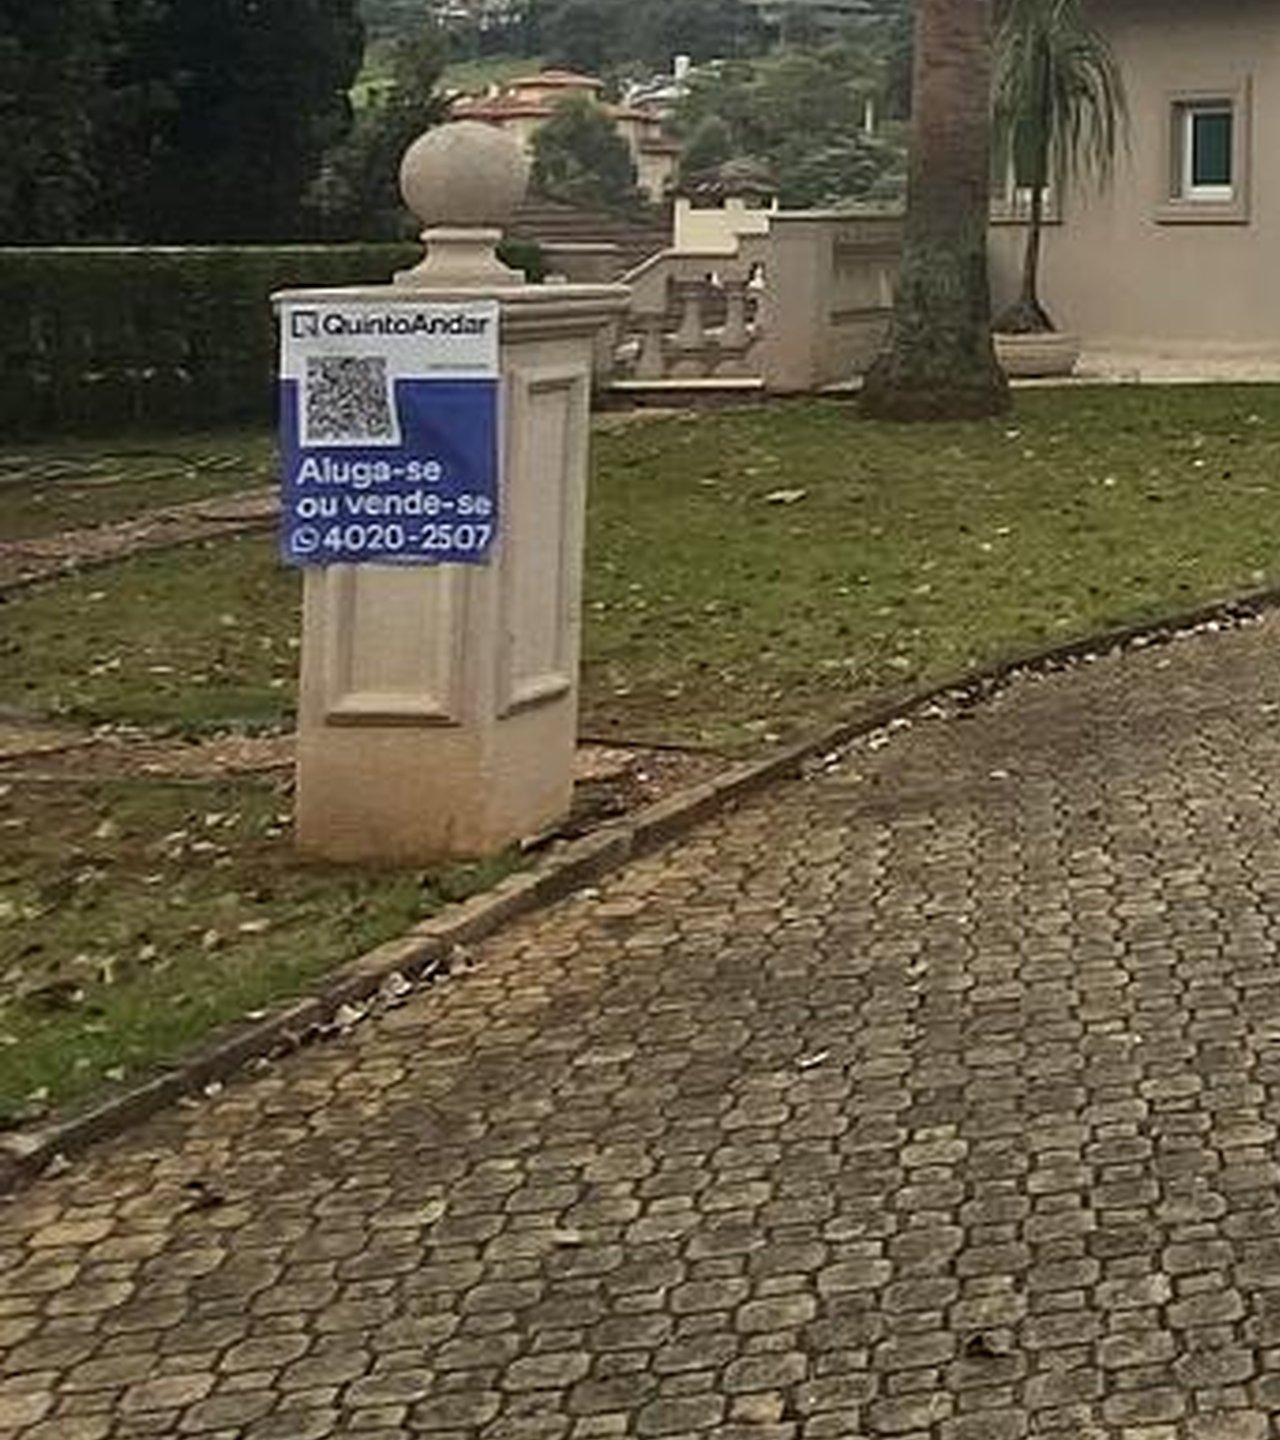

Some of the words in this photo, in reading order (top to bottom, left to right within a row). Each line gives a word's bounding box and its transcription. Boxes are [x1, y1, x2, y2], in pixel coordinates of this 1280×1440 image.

[322, 313, 489, 336] QuintoAndar
[296, 456, 442, 489] Aluga-se
[296, 496, 338, 519] ou
[346, 489, 493, 516] vende-se
[323, 524, 492, 551] 4020-2507
